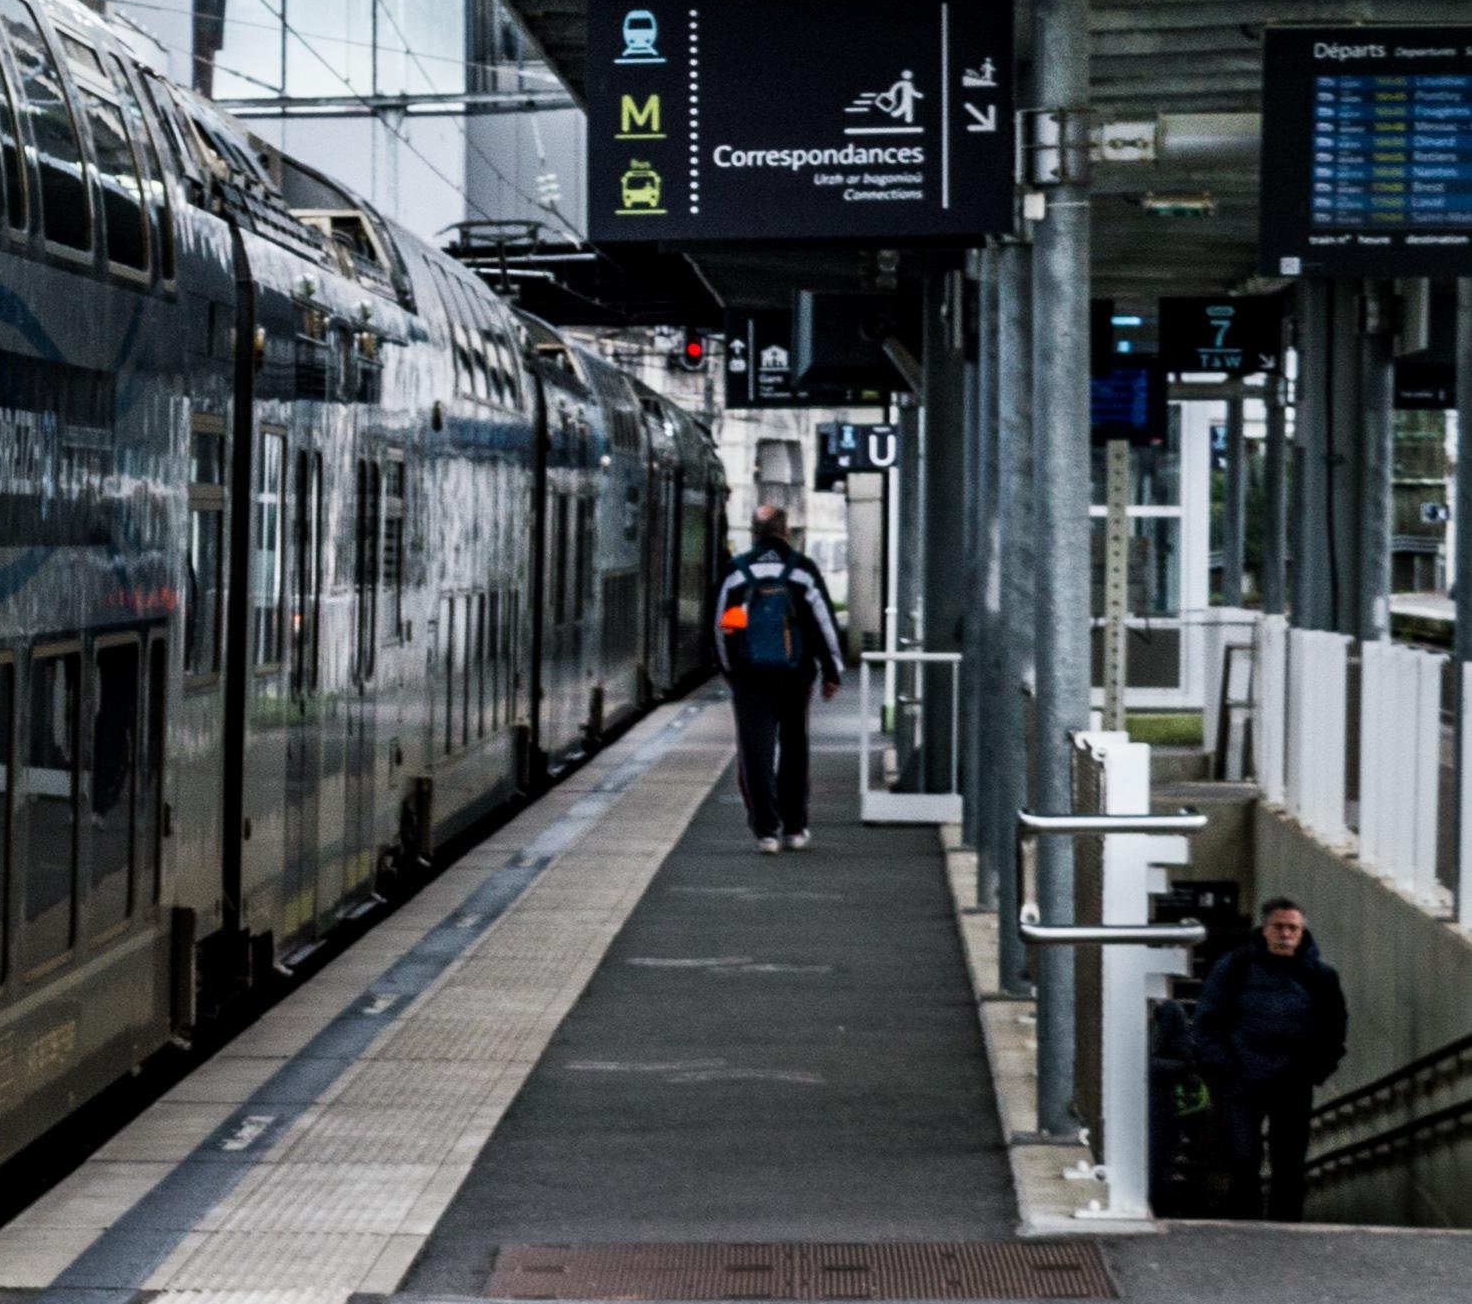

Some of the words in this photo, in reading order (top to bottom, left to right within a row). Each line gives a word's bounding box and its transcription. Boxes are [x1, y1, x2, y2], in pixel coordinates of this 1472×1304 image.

[1313, 42, 1386, 62] Départs
[621, 95, 660, 132] M
[713, 144, 924, 170] Correspondances
[843, 188, 923, 200] Connections
[1210, 320, 1231, 346] 7
[869, 434, 896, 467] U
